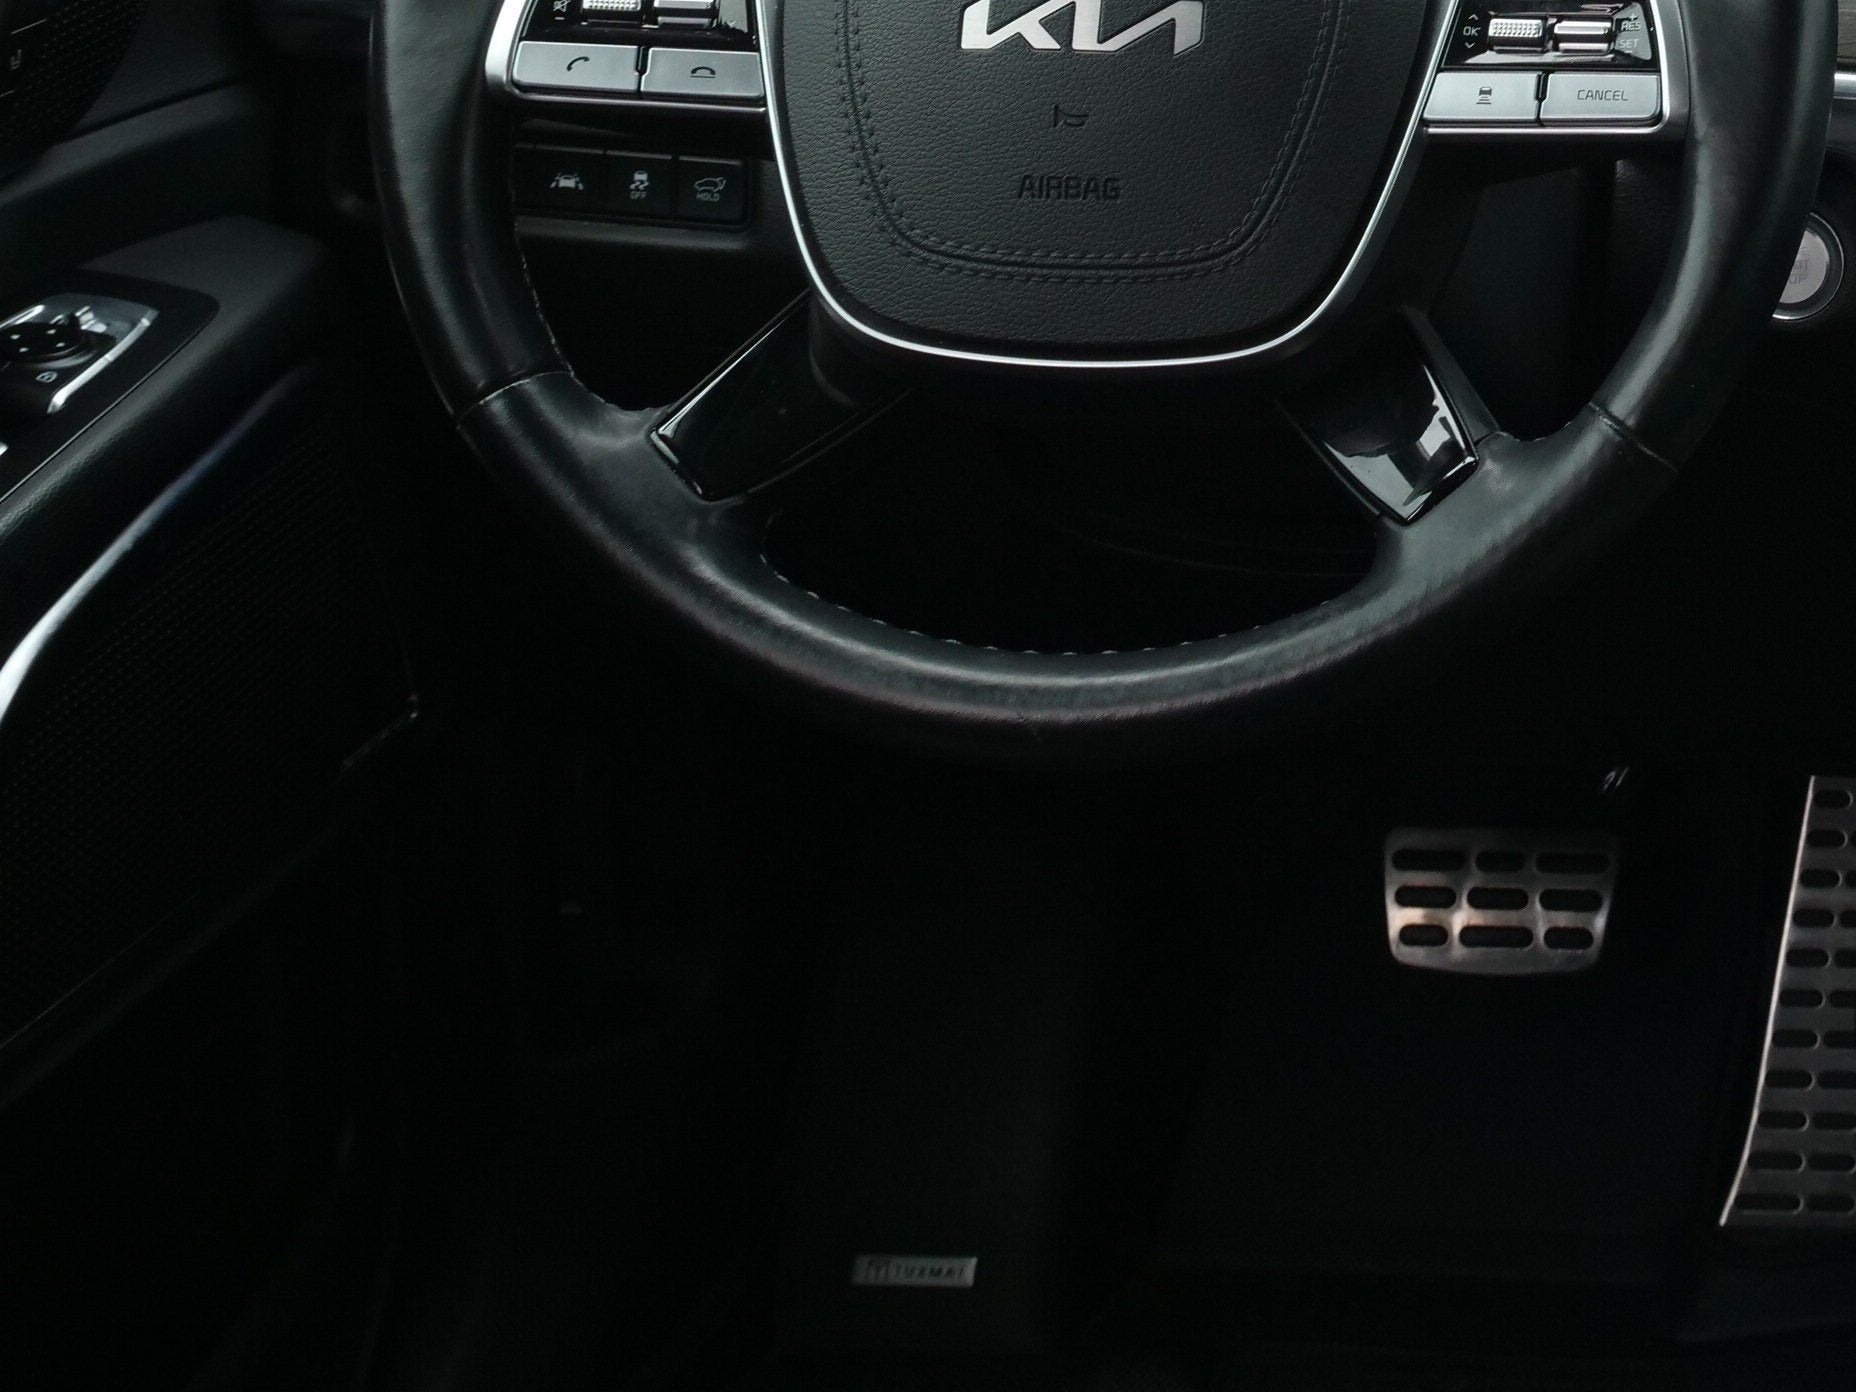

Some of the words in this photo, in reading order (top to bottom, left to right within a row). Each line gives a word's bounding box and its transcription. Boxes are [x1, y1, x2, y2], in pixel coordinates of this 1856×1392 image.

[1463, 26, 1478, 36] OK
[1621, 21, 1641, 31] RES
[1619, 39, 1639, 49] SET
[1577, 89, 1628, 102] CANCEL
[1018, 175, 1121, 200] AIRBAG
